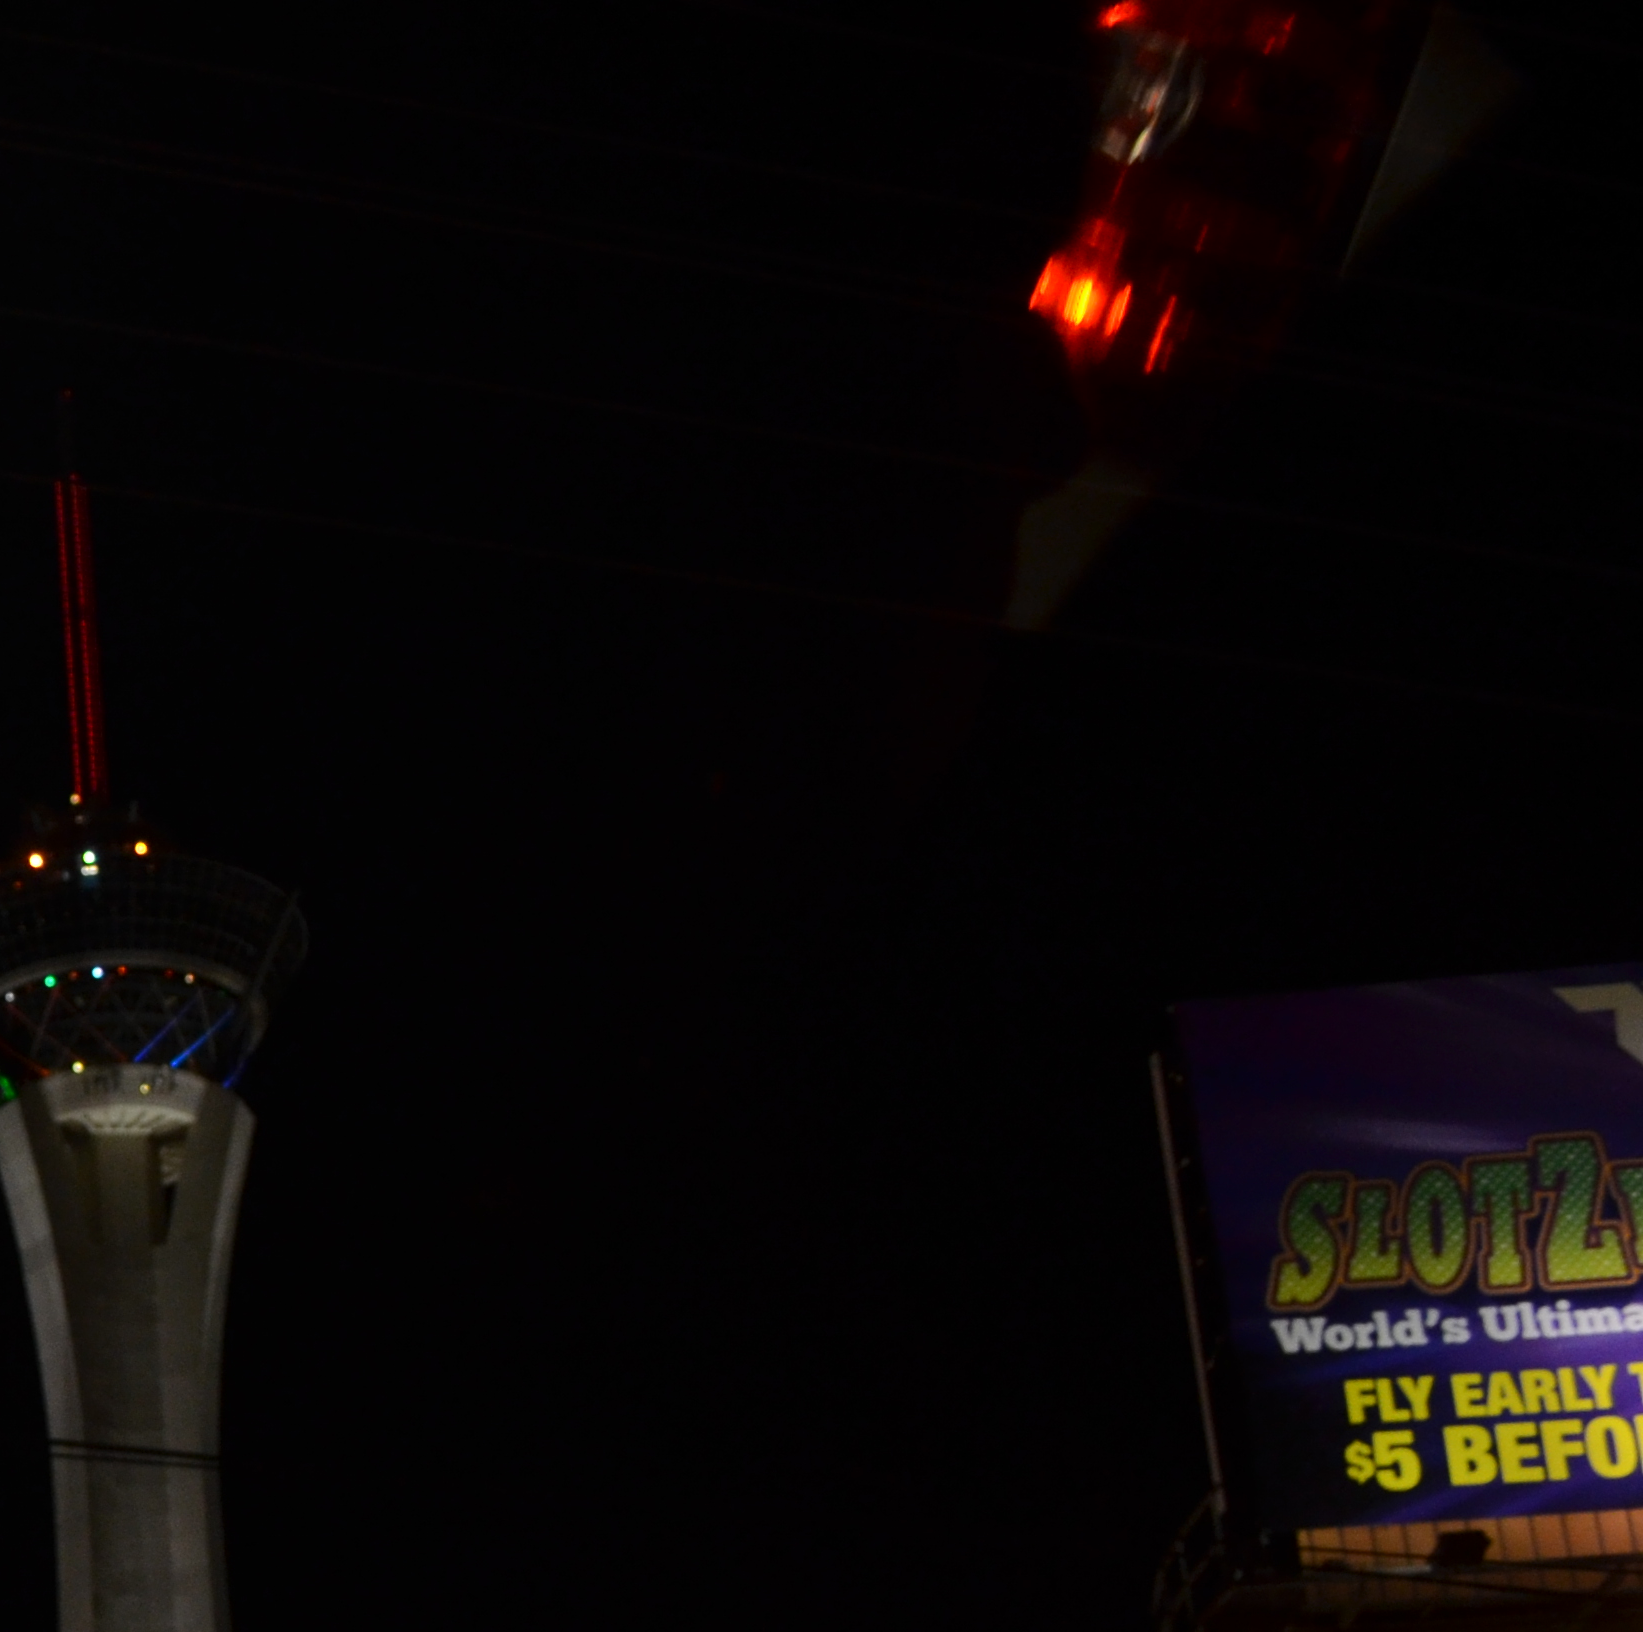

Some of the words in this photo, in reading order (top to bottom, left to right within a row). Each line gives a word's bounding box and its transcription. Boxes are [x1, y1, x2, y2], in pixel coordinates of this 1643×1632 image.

[1270, 1306, 1471, 1353] World's
[1343, 1375, 1434, 1424] FLY
[1450, 1363, 1617, 1418] EARLY
[1344, 1430, 1422, 1492] $5
[1442, 1414, 1643, 1487] BEFO
